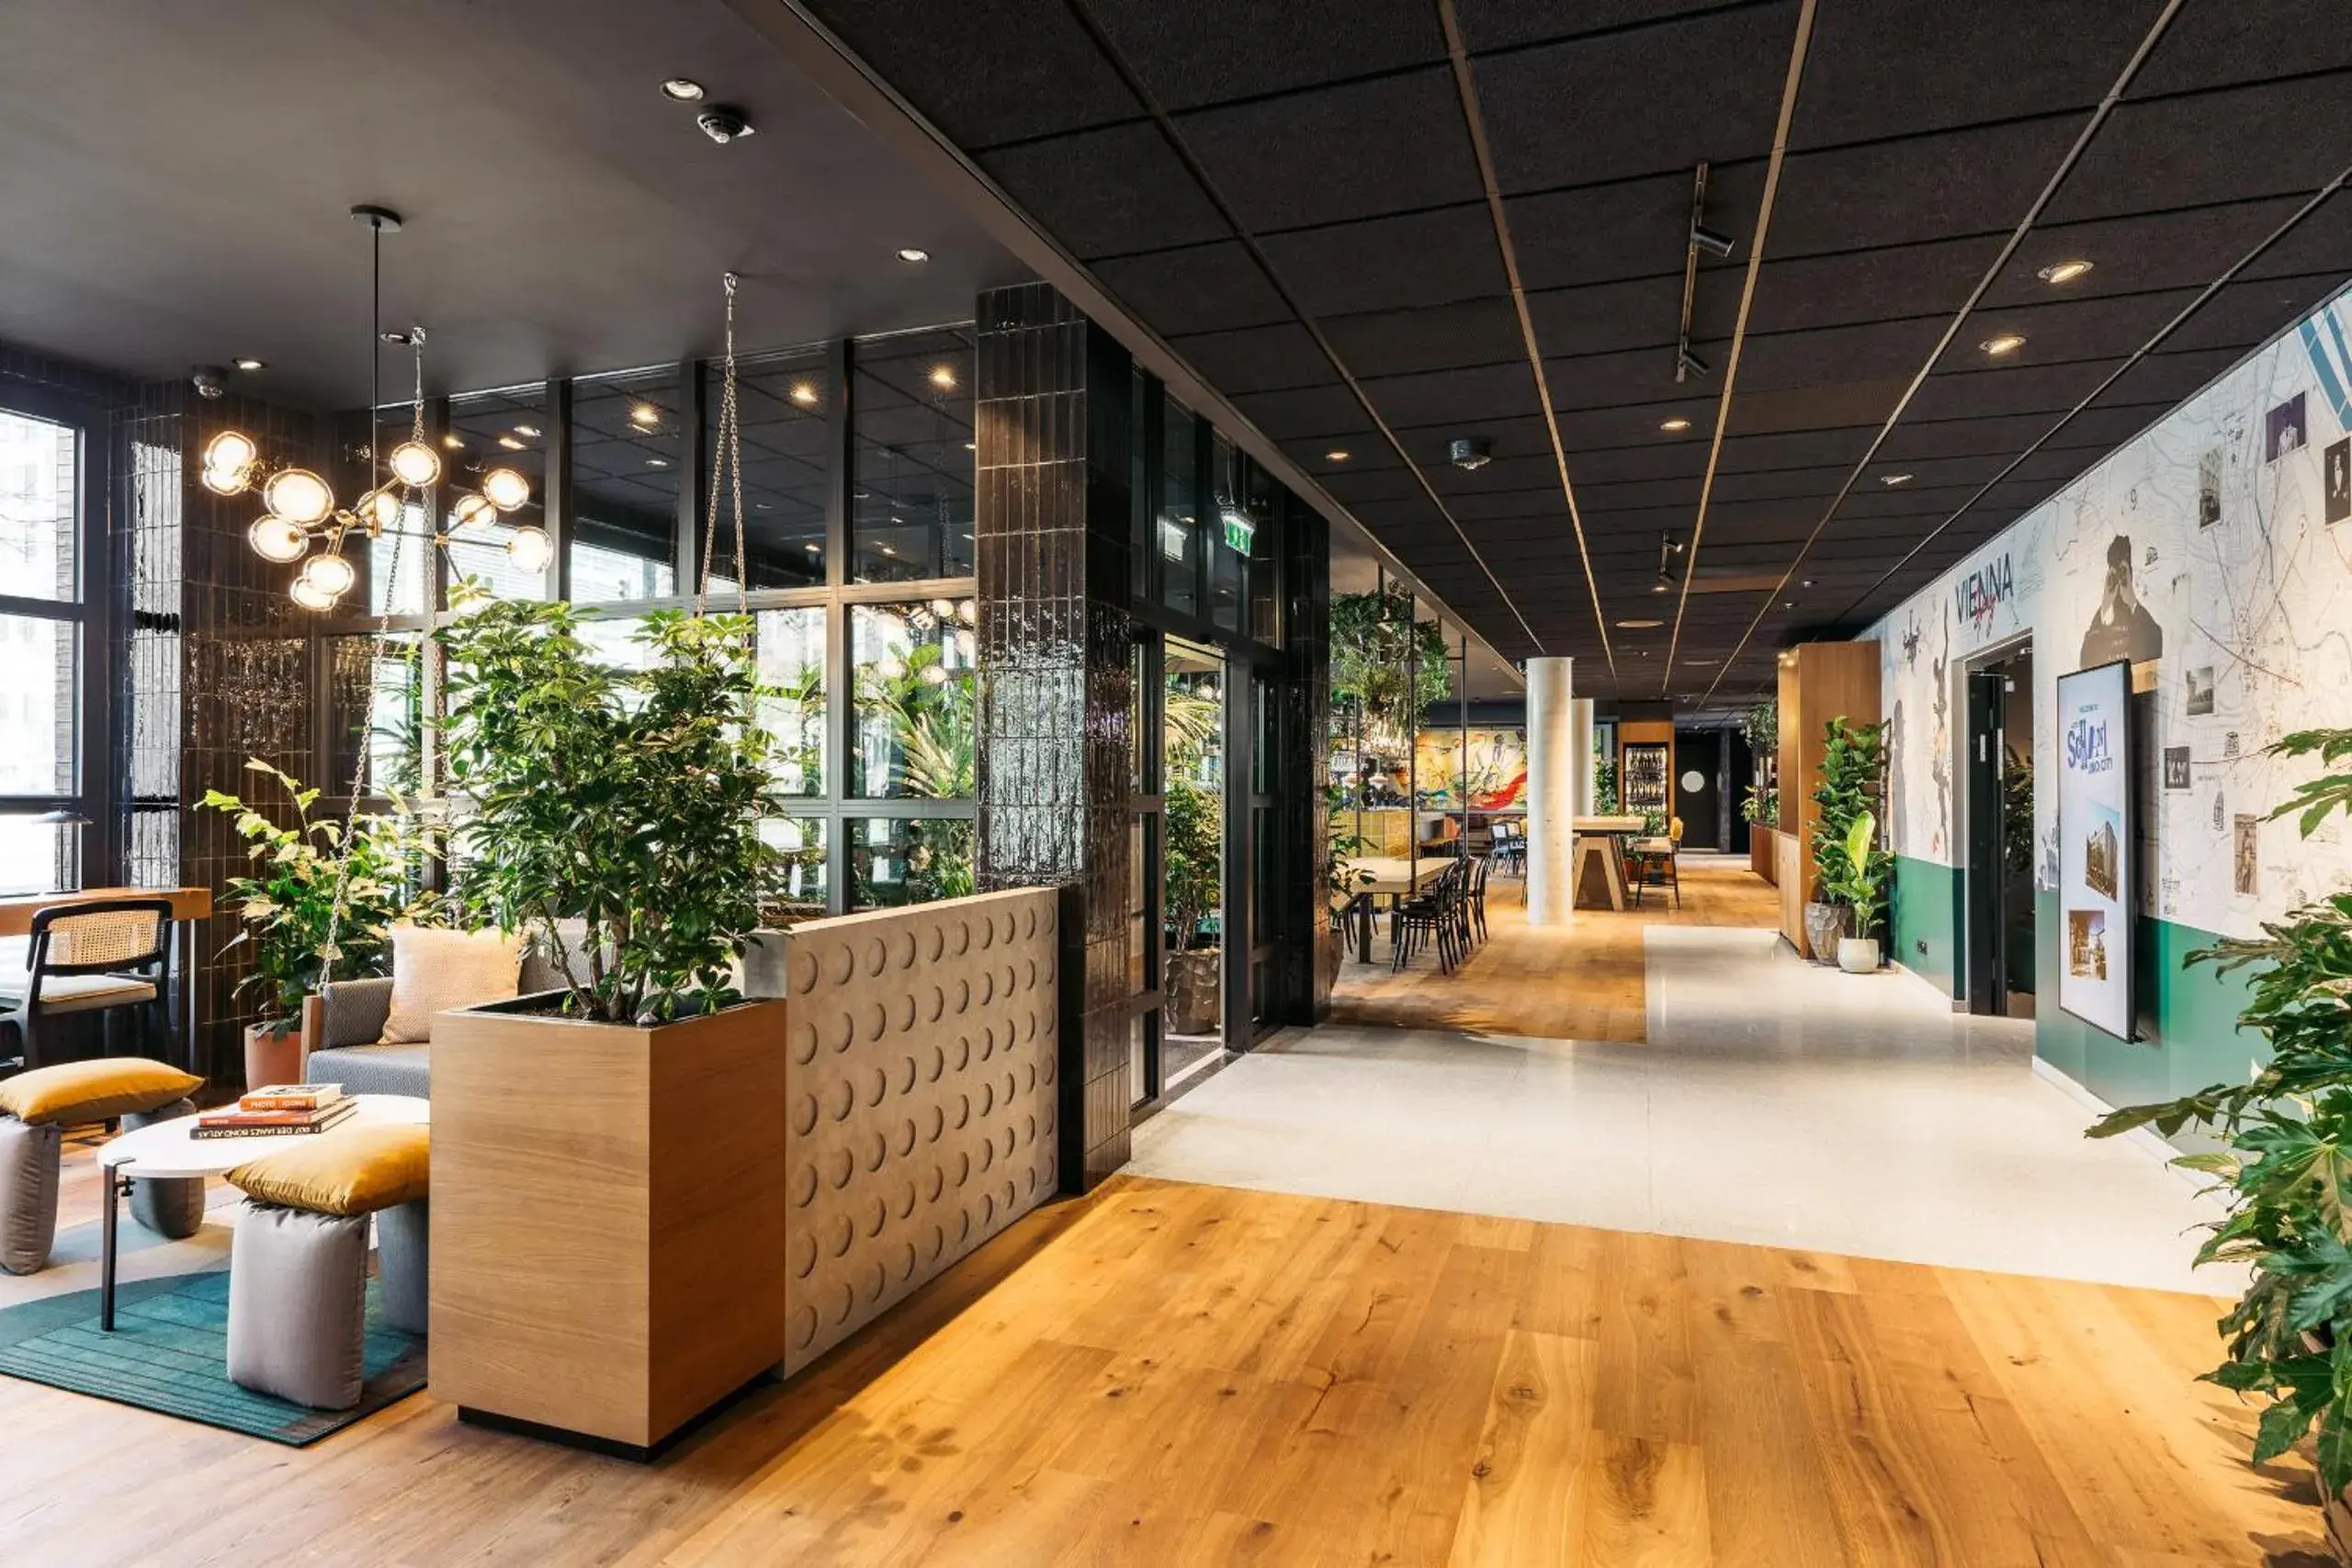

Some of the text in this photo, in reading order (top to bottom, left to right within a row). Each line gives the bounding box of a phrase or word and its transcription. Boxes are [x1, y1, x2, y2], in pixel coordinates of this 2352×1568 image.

[1955, 553, 2014, 625] VIENNA
[250, 1100, 276, 1110] PHOTO
[198, 1130, 224, 1139] ATLAS
[224, 1129, 248, 1138] BOND
